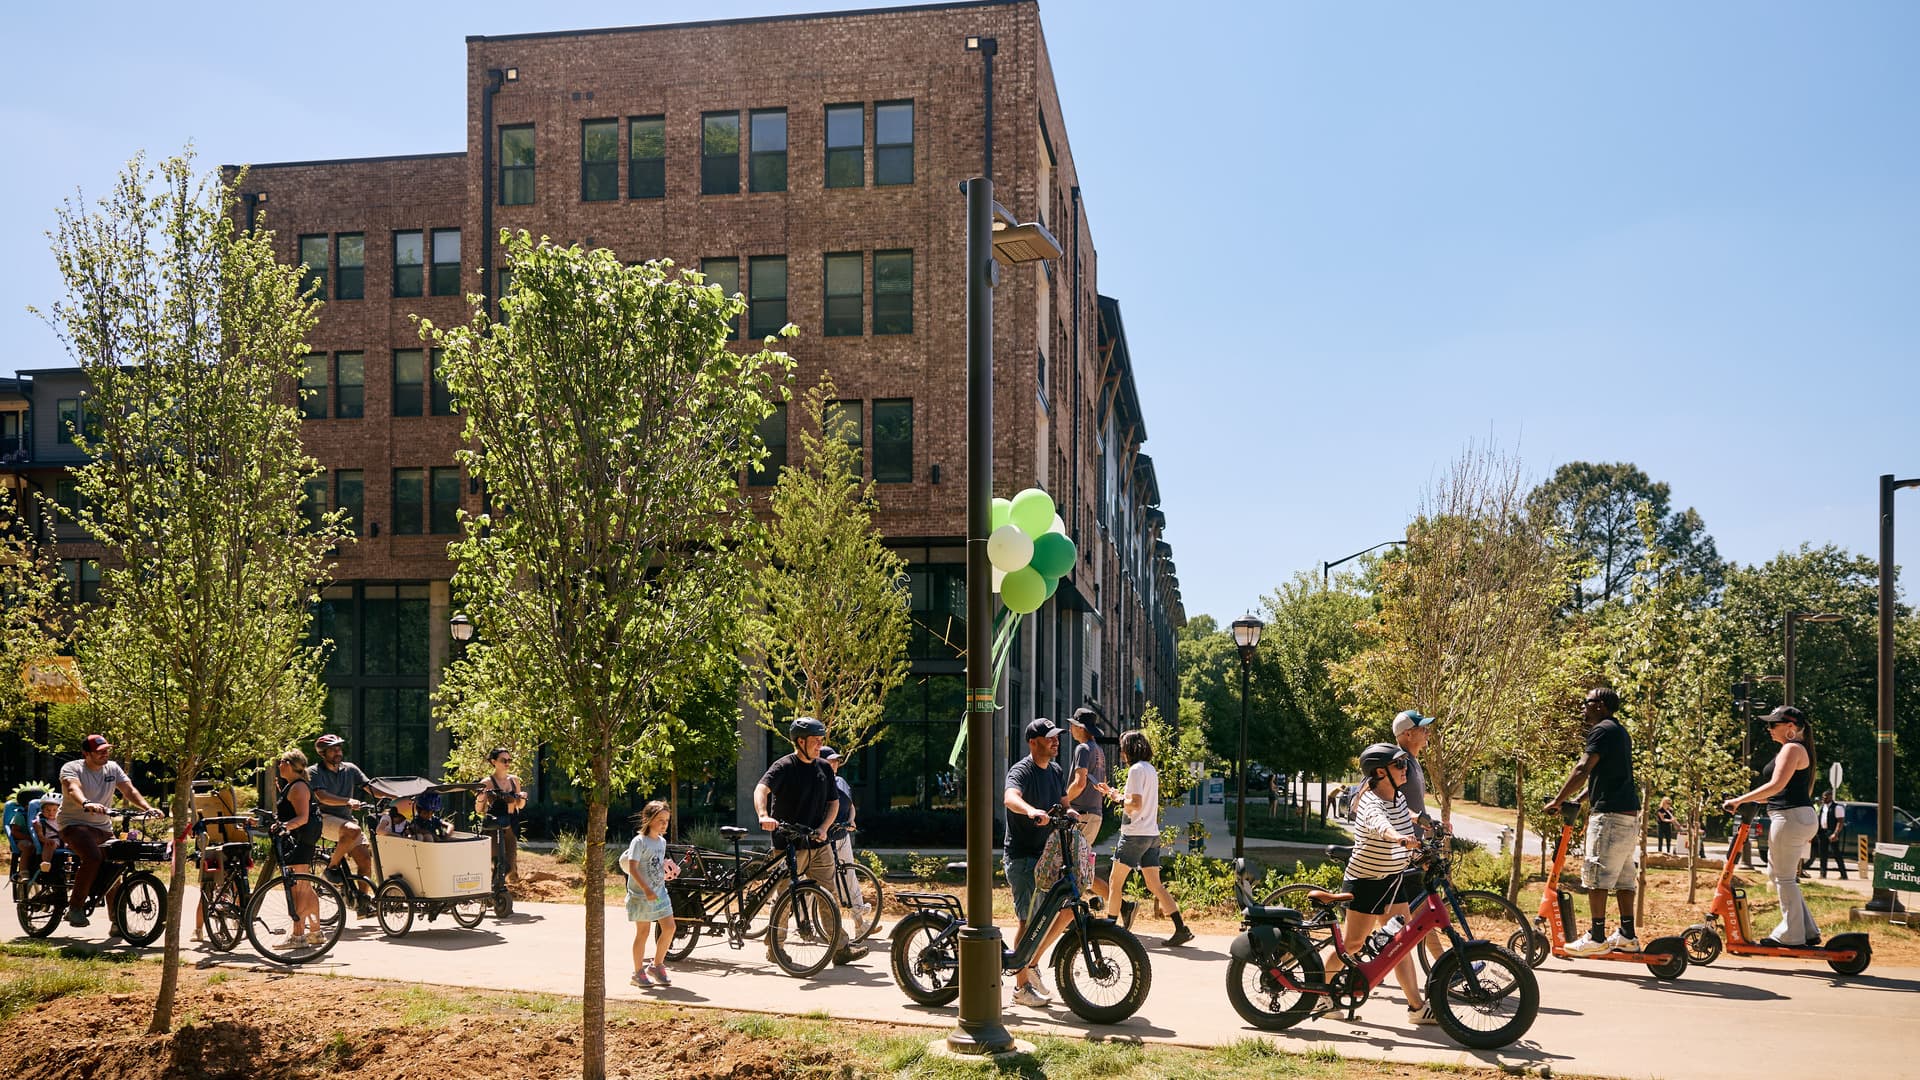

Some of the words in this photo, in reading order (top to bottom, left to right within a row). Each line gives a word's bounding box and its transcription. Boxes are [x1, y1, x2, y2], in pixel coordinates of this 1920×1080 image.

[1893, 862, 1916, 872] Bike
[1552, 901, 1562, 927] BIRD
[1726, 900, 1737, 925] BIRD
[1030, 915, 1047, 941] HEYBIKE
[1128, 960, 1141, 1003] KENDA
